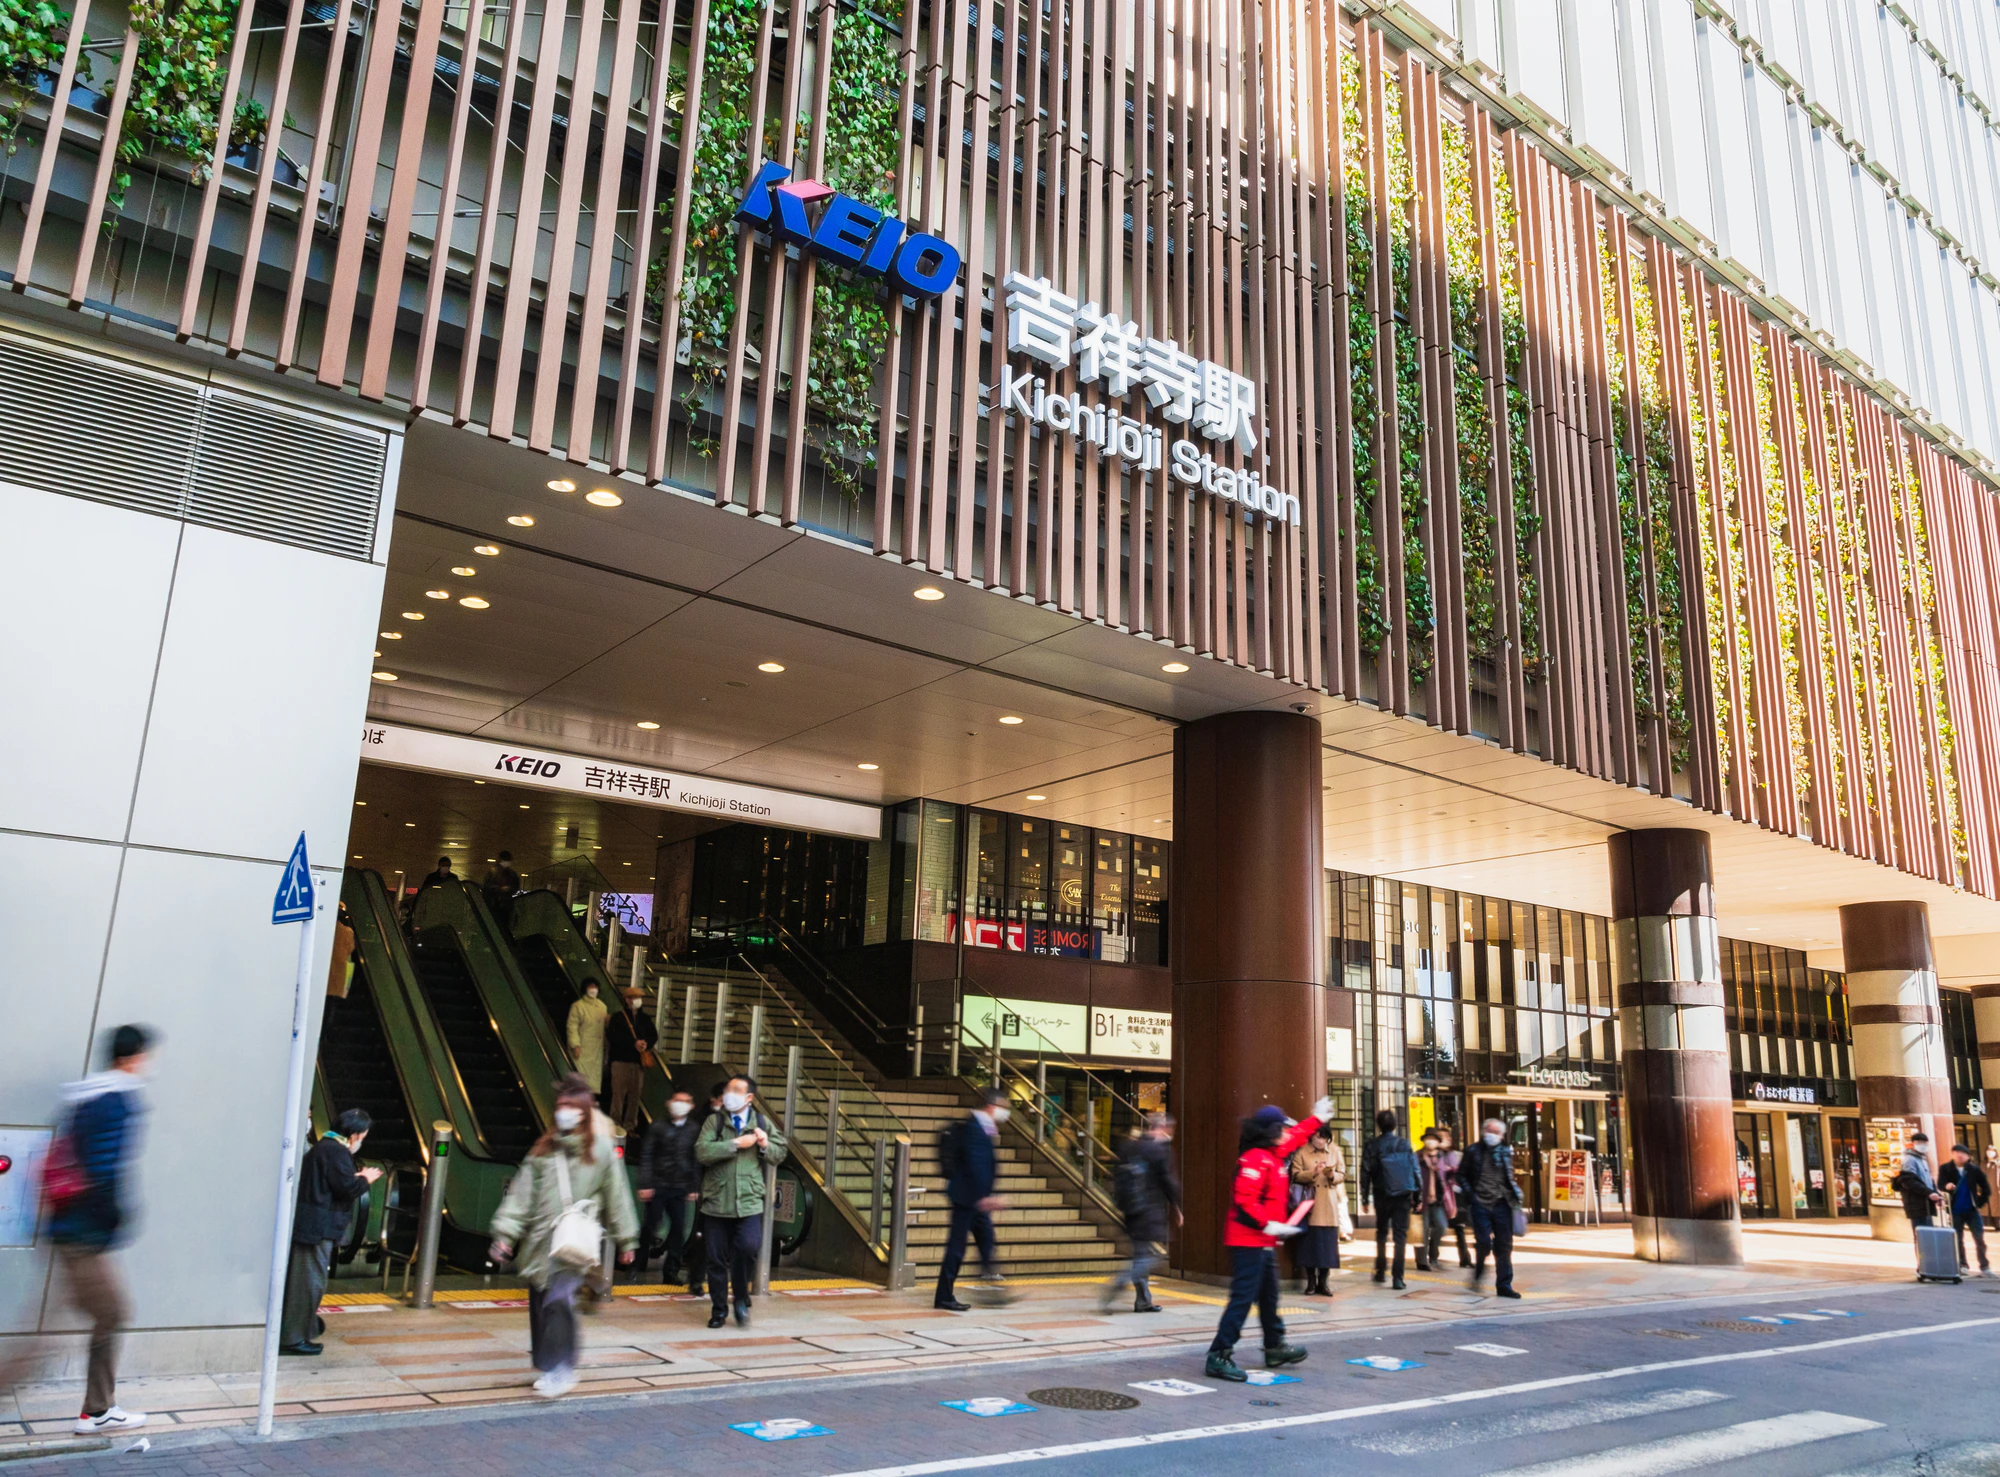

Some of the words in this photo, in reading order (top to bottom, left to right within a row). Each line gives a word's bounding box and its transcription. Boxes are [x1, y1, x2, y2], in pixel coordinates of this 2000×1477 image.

[735, 160, 960, 300] KEIO
[1003, 271, 1258, 457] 吉祥寺駅
[1001, 364, 1162, 472] Kichijōji
[1172, 439, 1300, 527] Station
[495, 754, 561, 778] KEIO
[585, 766, 671, 799] 吉祥寺駅
[729, 799, 771, 816] Station
[1024, 1015, 1070, 1028] エレベーター
[1095, 1013, 1123, 1037] B1F
[1530, 1065, 1550, 1084] Le
[1551, 1069, 1591, 1089] repas
